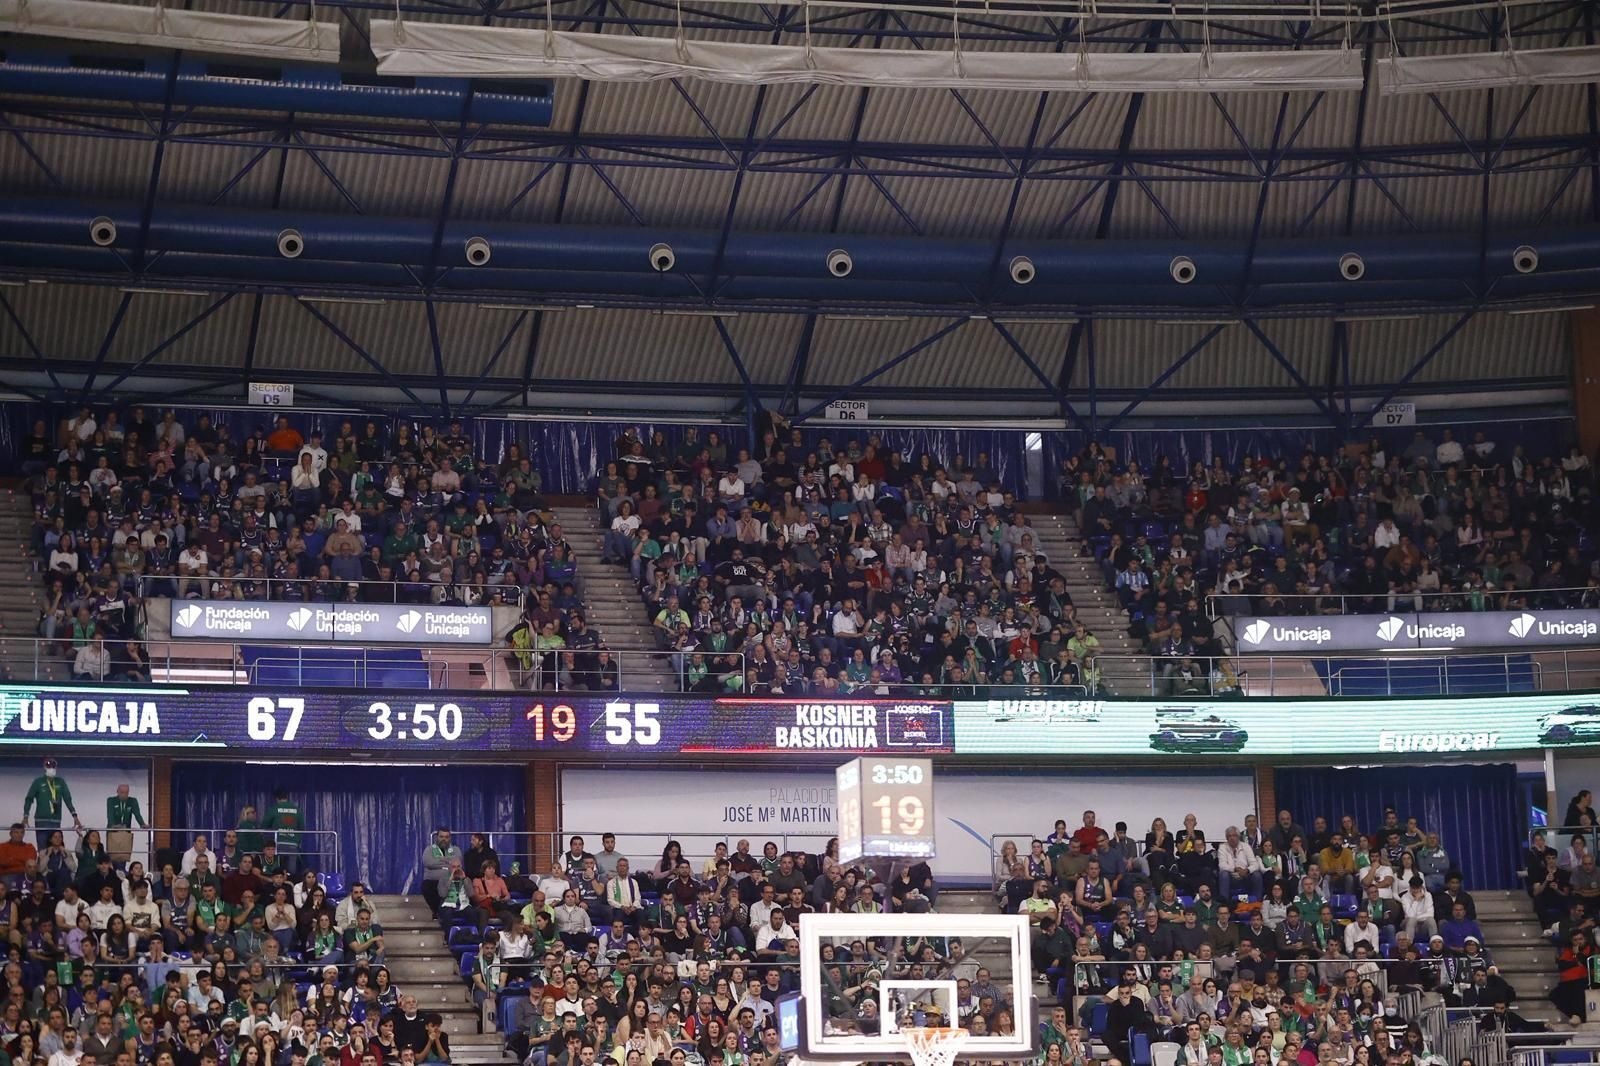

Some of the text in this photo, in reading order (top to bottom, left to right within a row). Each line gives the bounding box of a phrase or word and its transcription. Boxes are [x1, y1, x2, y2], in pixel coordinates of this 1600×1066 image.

[252, 384, 291, 393] SECTOR
[263, 394, 280, 405] D5
[839, 410, 856, 420] D6
[1386, 414, 1403, 424] D7
[205, 606, 270, 620] Fundación
[315, 609, 380, 623] Fundación
[425, 612, 487, 625] Fundación
[205, 618, 252, 631] Unicaja
[315, 621, 362, 634] Unicaja
[425, 623, 470, 637] Unicaja
[1406, 623, 1465, 641] Unicaja
[1538, 620, 1597, 638] Unicaja
[1273, 626, 1332, 644] Unicaja
[20, 699, 161, 734] UNICAJA
[247, 697, 305, 741] 67
[367, 702, 464, 740] 3:50
[526, 703, 577, 741] 19
[605, 703, 661, 745] 55
[796, 705, 878, 726] KOSNER
[775, 727, 878, 748] BASKONIA
[1379, 731, 1500, 752] Europcar
[871, 764, 924, 784] 3:50
[769, 787, 836, 804] PALACIO DE
[722, 804, 753, 822] JOSÉ
[780, 804, 831, 822] MARTÍN
[871, 795, 925, 836] 19
